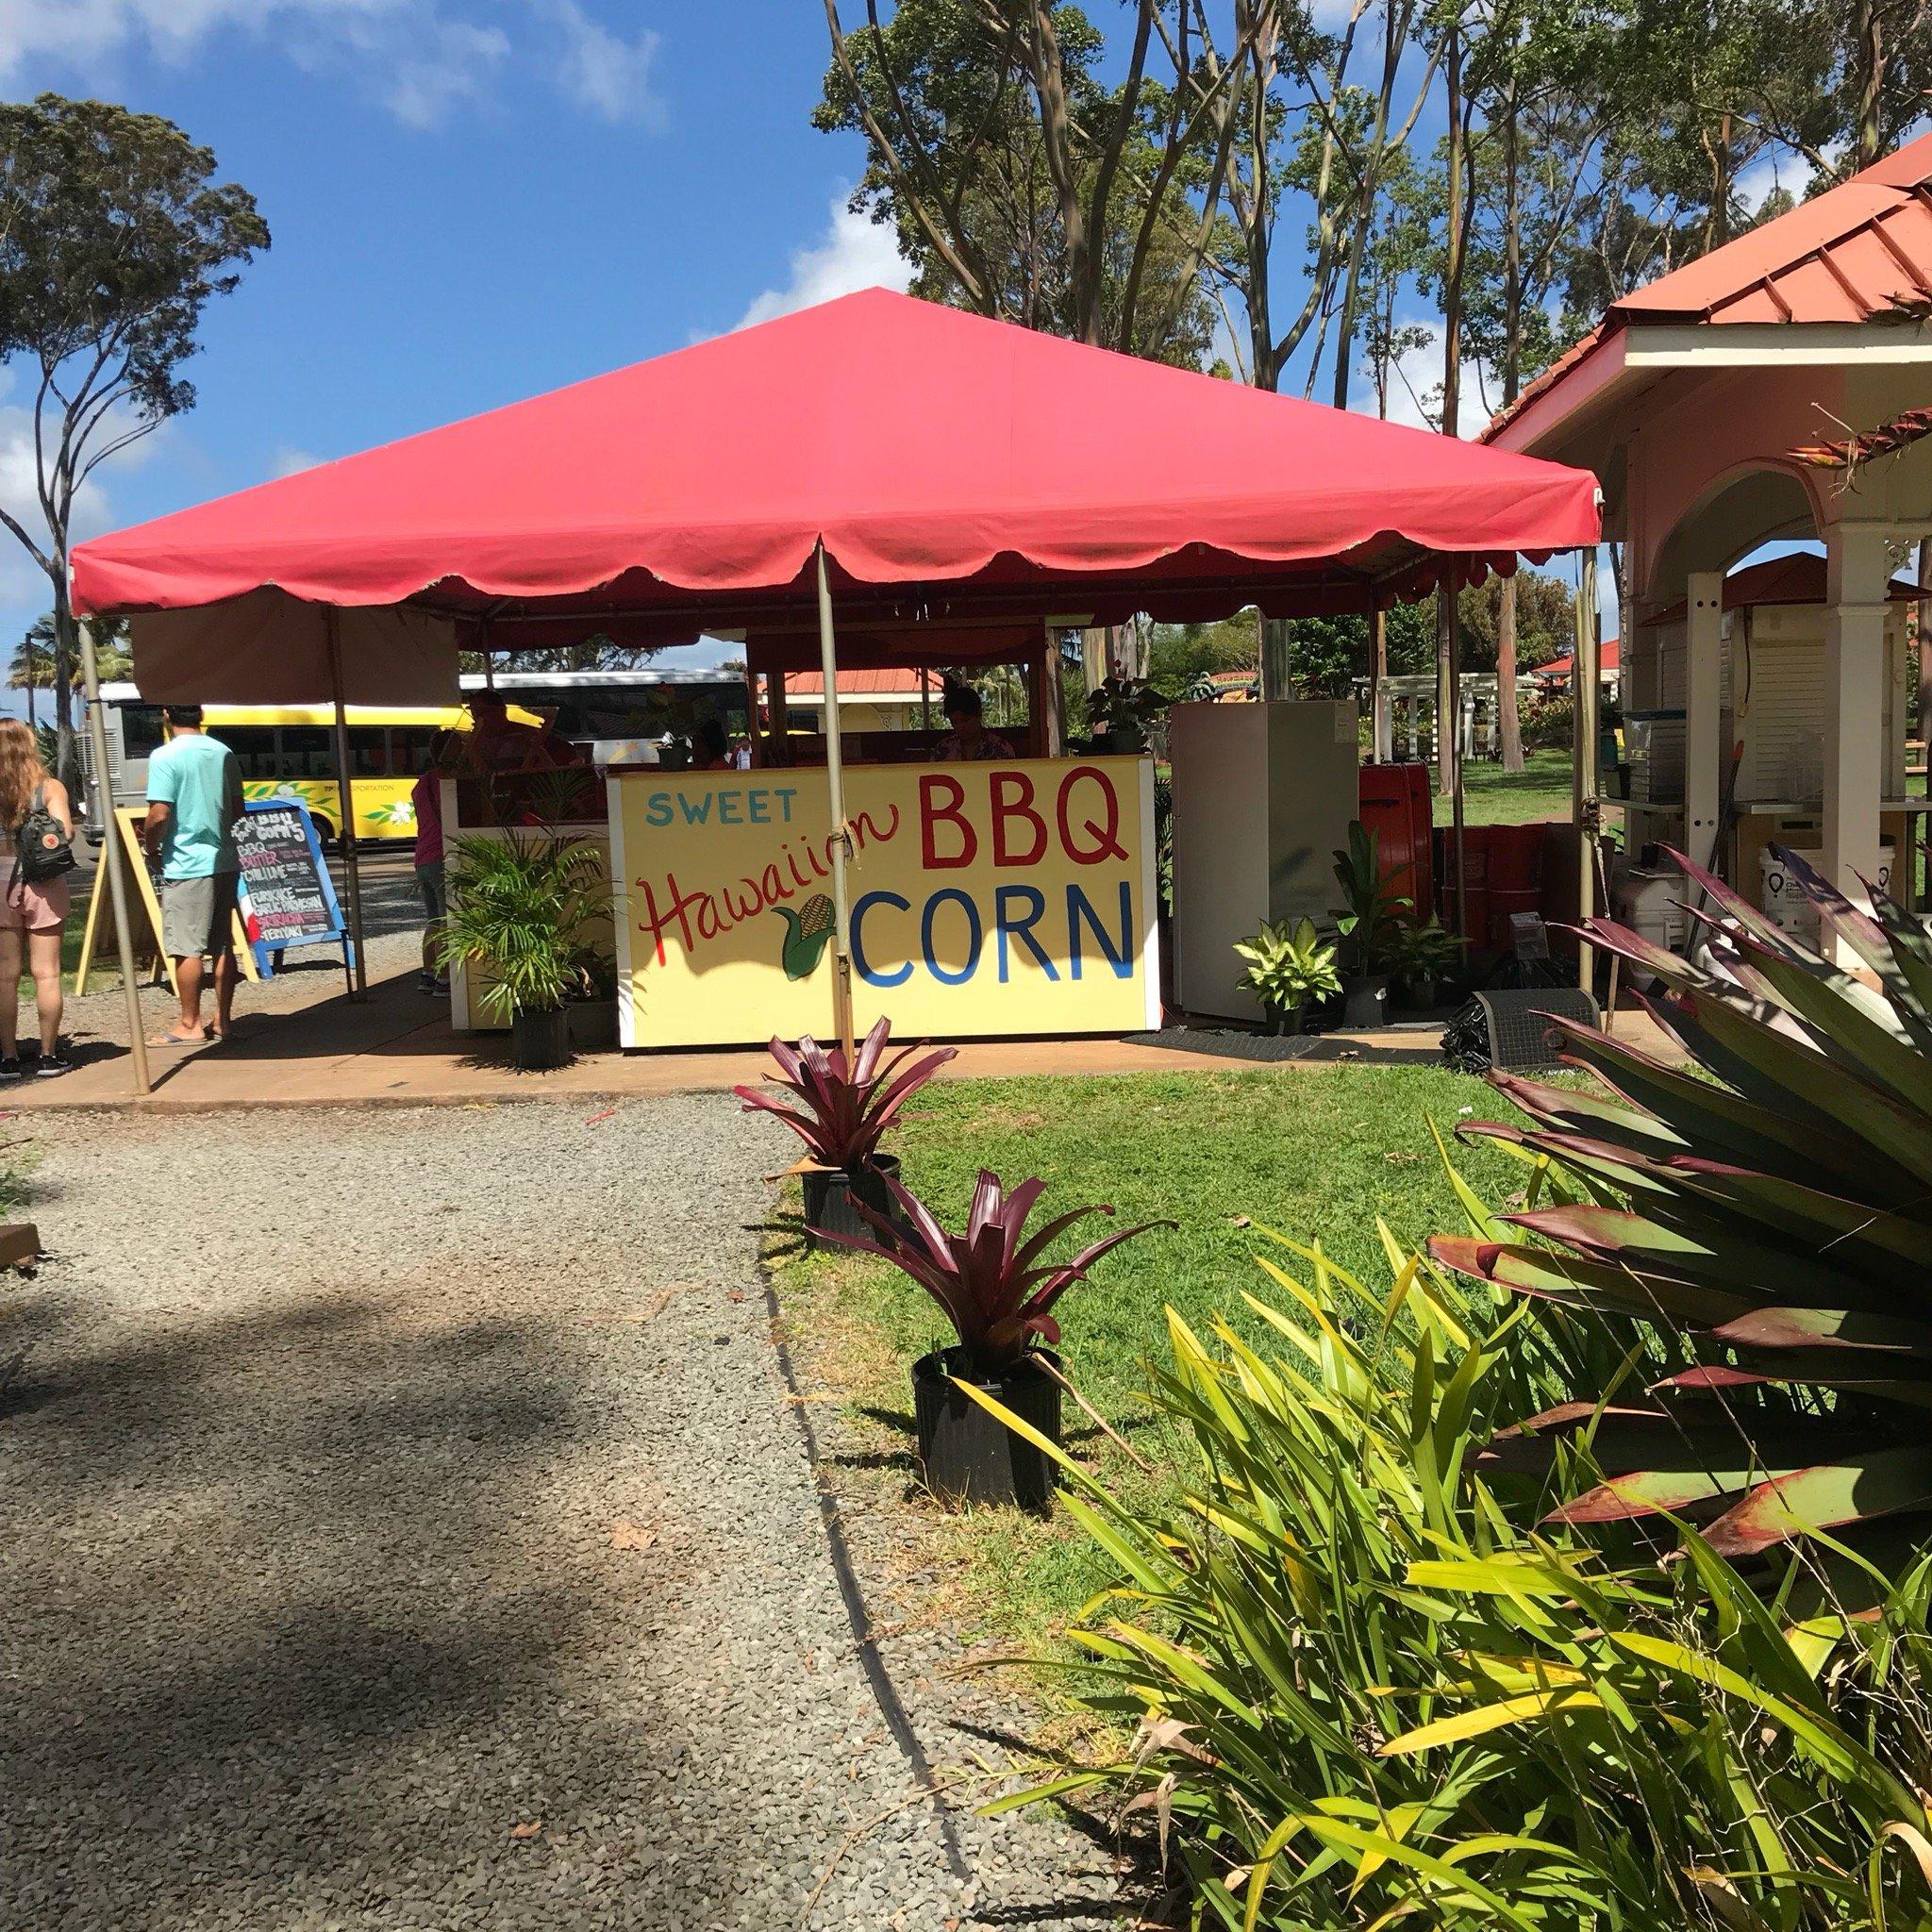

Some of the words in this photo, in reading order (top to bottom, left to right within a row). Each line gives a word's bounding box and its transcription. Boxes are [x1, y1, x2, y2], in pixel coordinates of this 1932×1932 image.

[646, 789, 797, 826] SWEET
[919, 765, 1129, 870] BBQ
[237, 841, 269, 857] BBQ
[850, 882, 1133, 988] CORN
